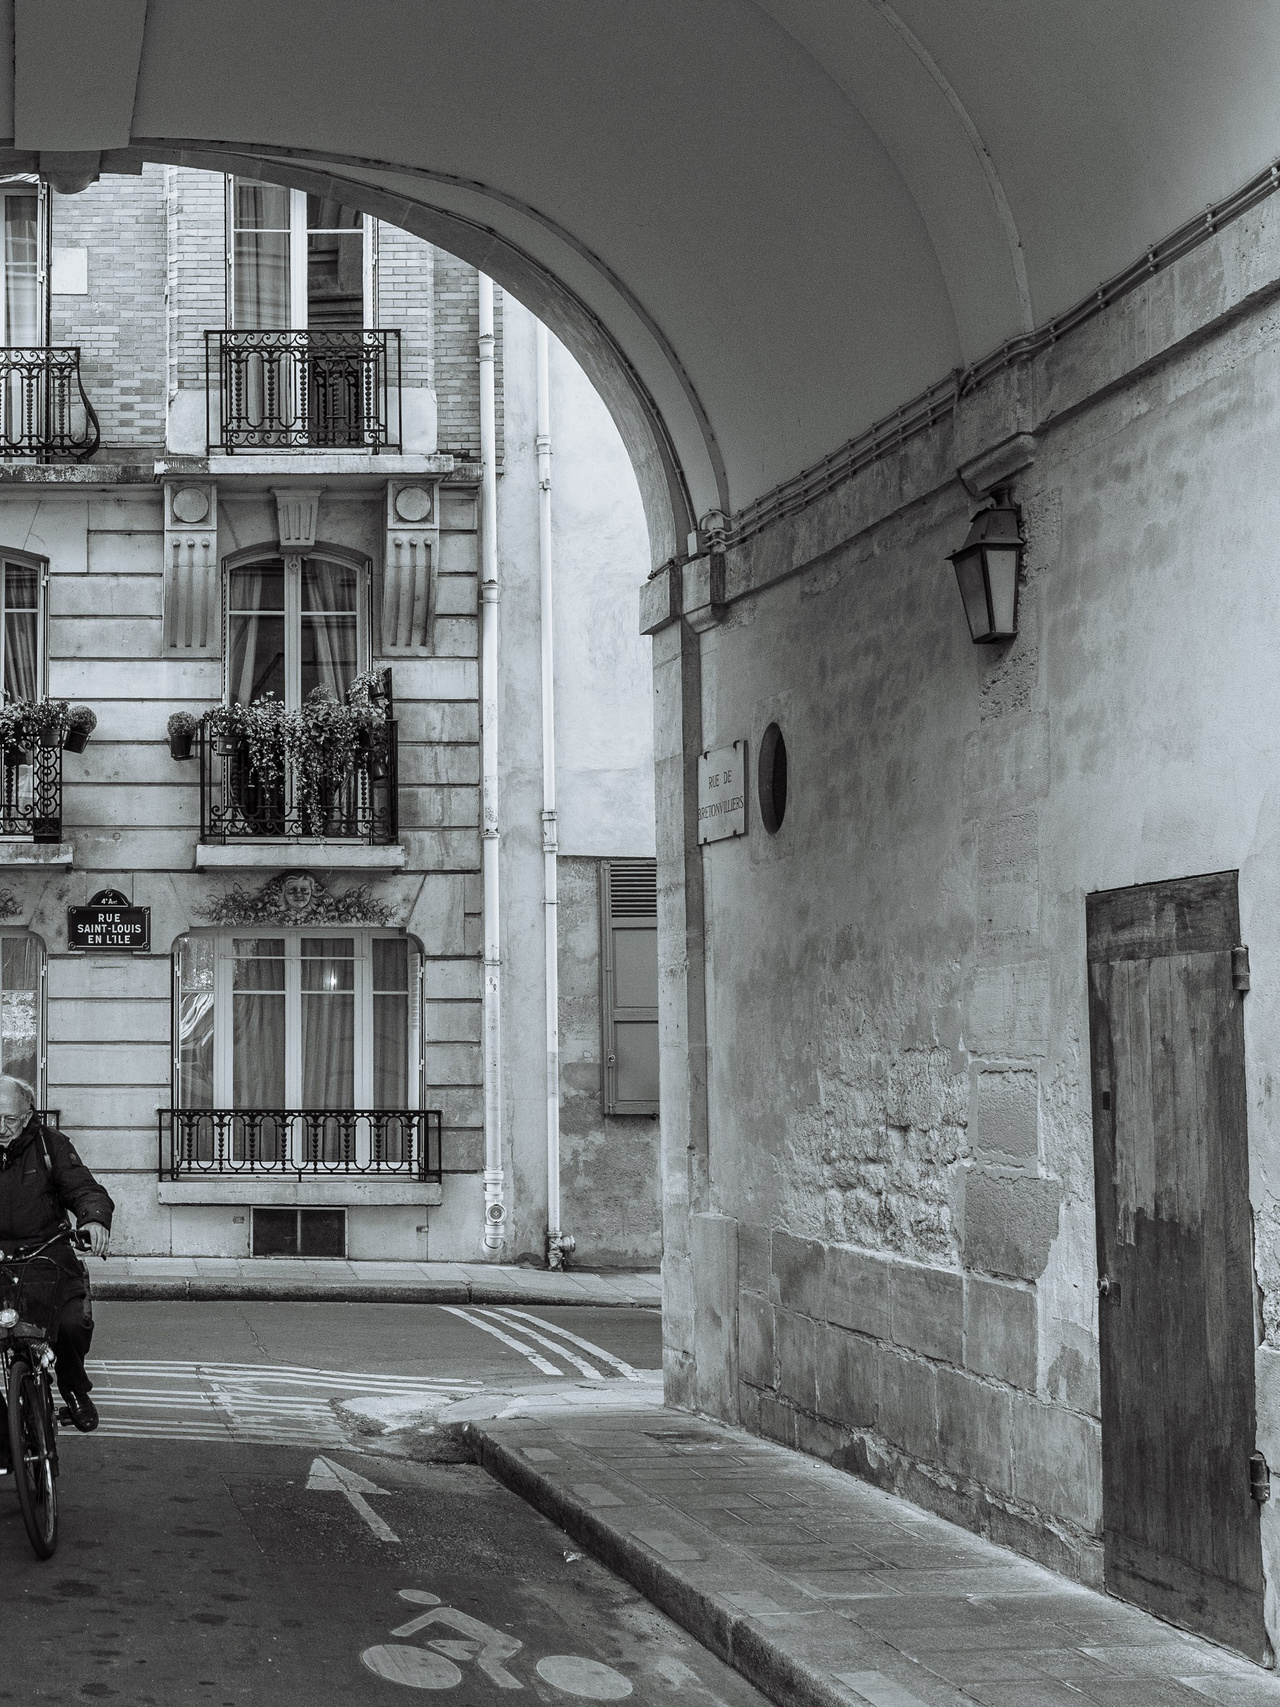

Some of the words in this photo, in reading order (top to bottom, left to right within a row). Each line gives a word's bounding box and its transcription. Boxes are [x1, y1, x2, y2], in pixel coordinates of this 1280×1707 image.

[709, 774, 720, 790] RUE
[724, 770, 732, 784] DE
[698, 795, 744, 820] BRETONVILLIERS
[98, 913, 121, 922] RUE
[77, 924, 142, 933] SAINT-LOUIS
[88, 935, 102, 944] EN
